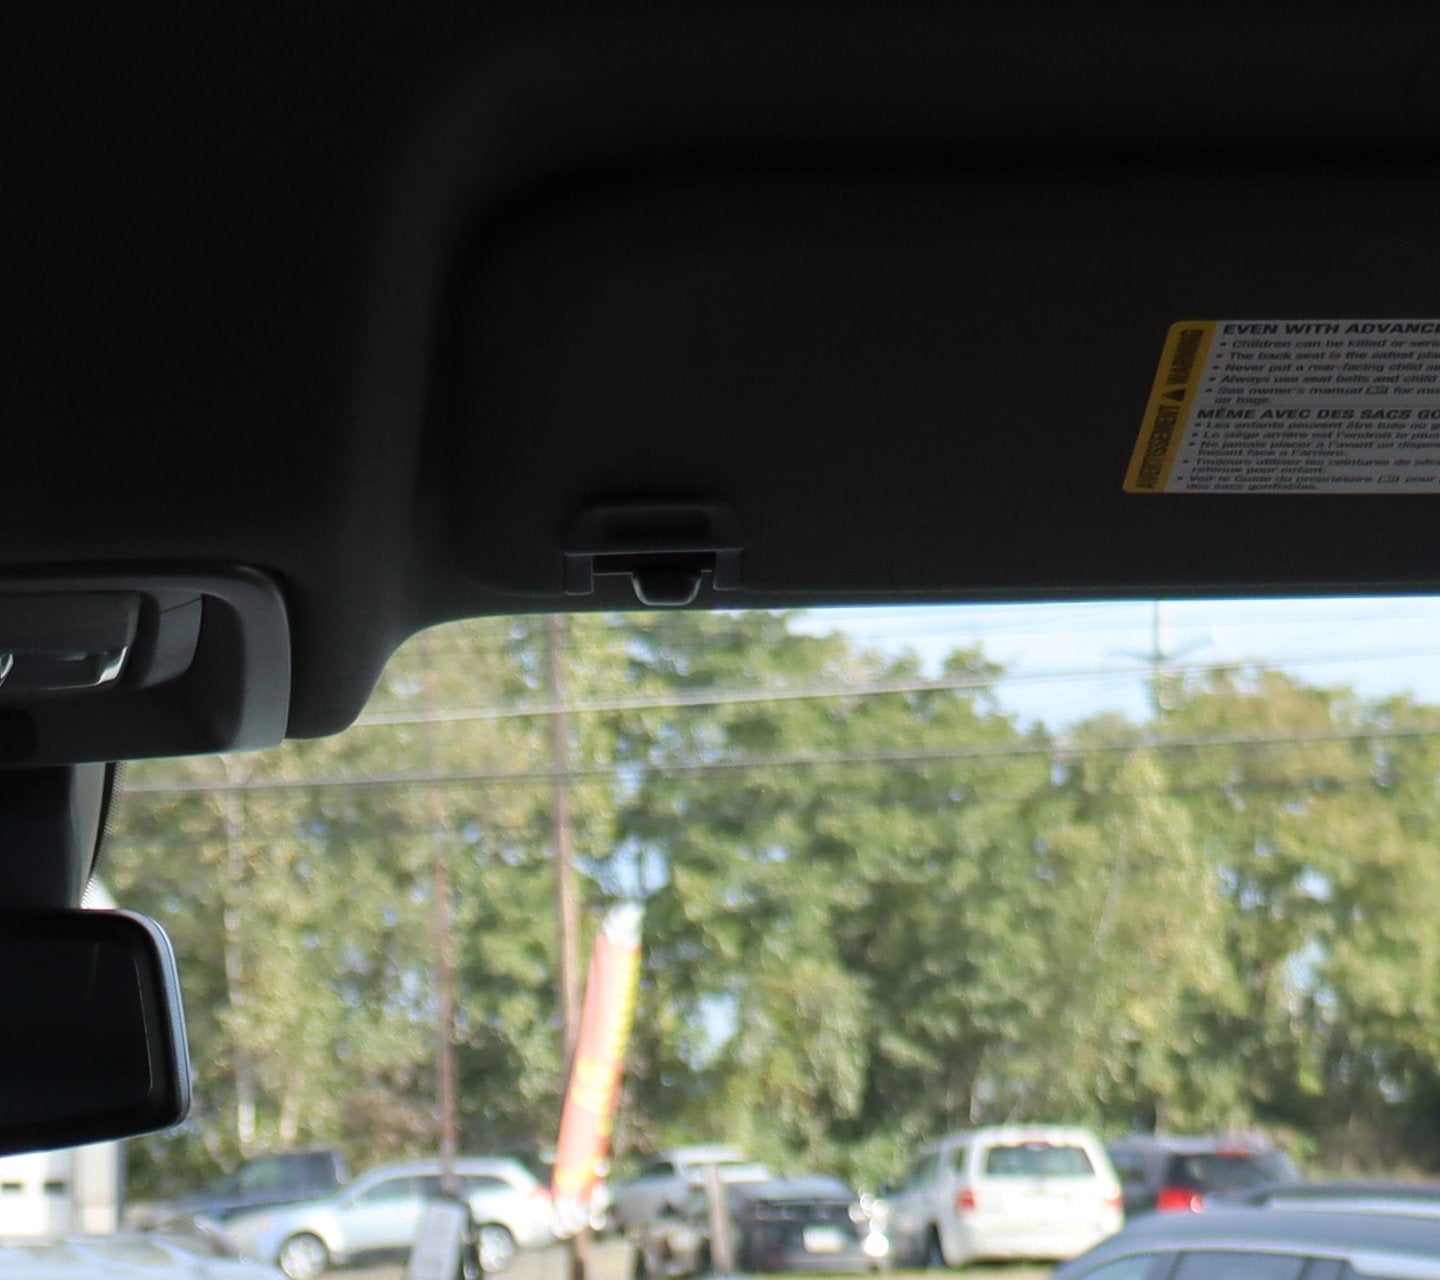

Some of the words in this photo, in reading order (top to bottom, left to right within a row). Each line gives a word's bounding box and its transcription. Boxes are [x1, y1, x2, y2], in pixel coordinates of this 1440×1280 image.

[1222, 323, 1279, 335] EVEN
[1284, 323, 1340, 335] WITH
[1197, 406, 1257, 419] MÊME
[1259, 409, 1312, 419] AVEC
[1317, 409, 1354, 419] DES
[1359, 408, 1414, 419] SACS
